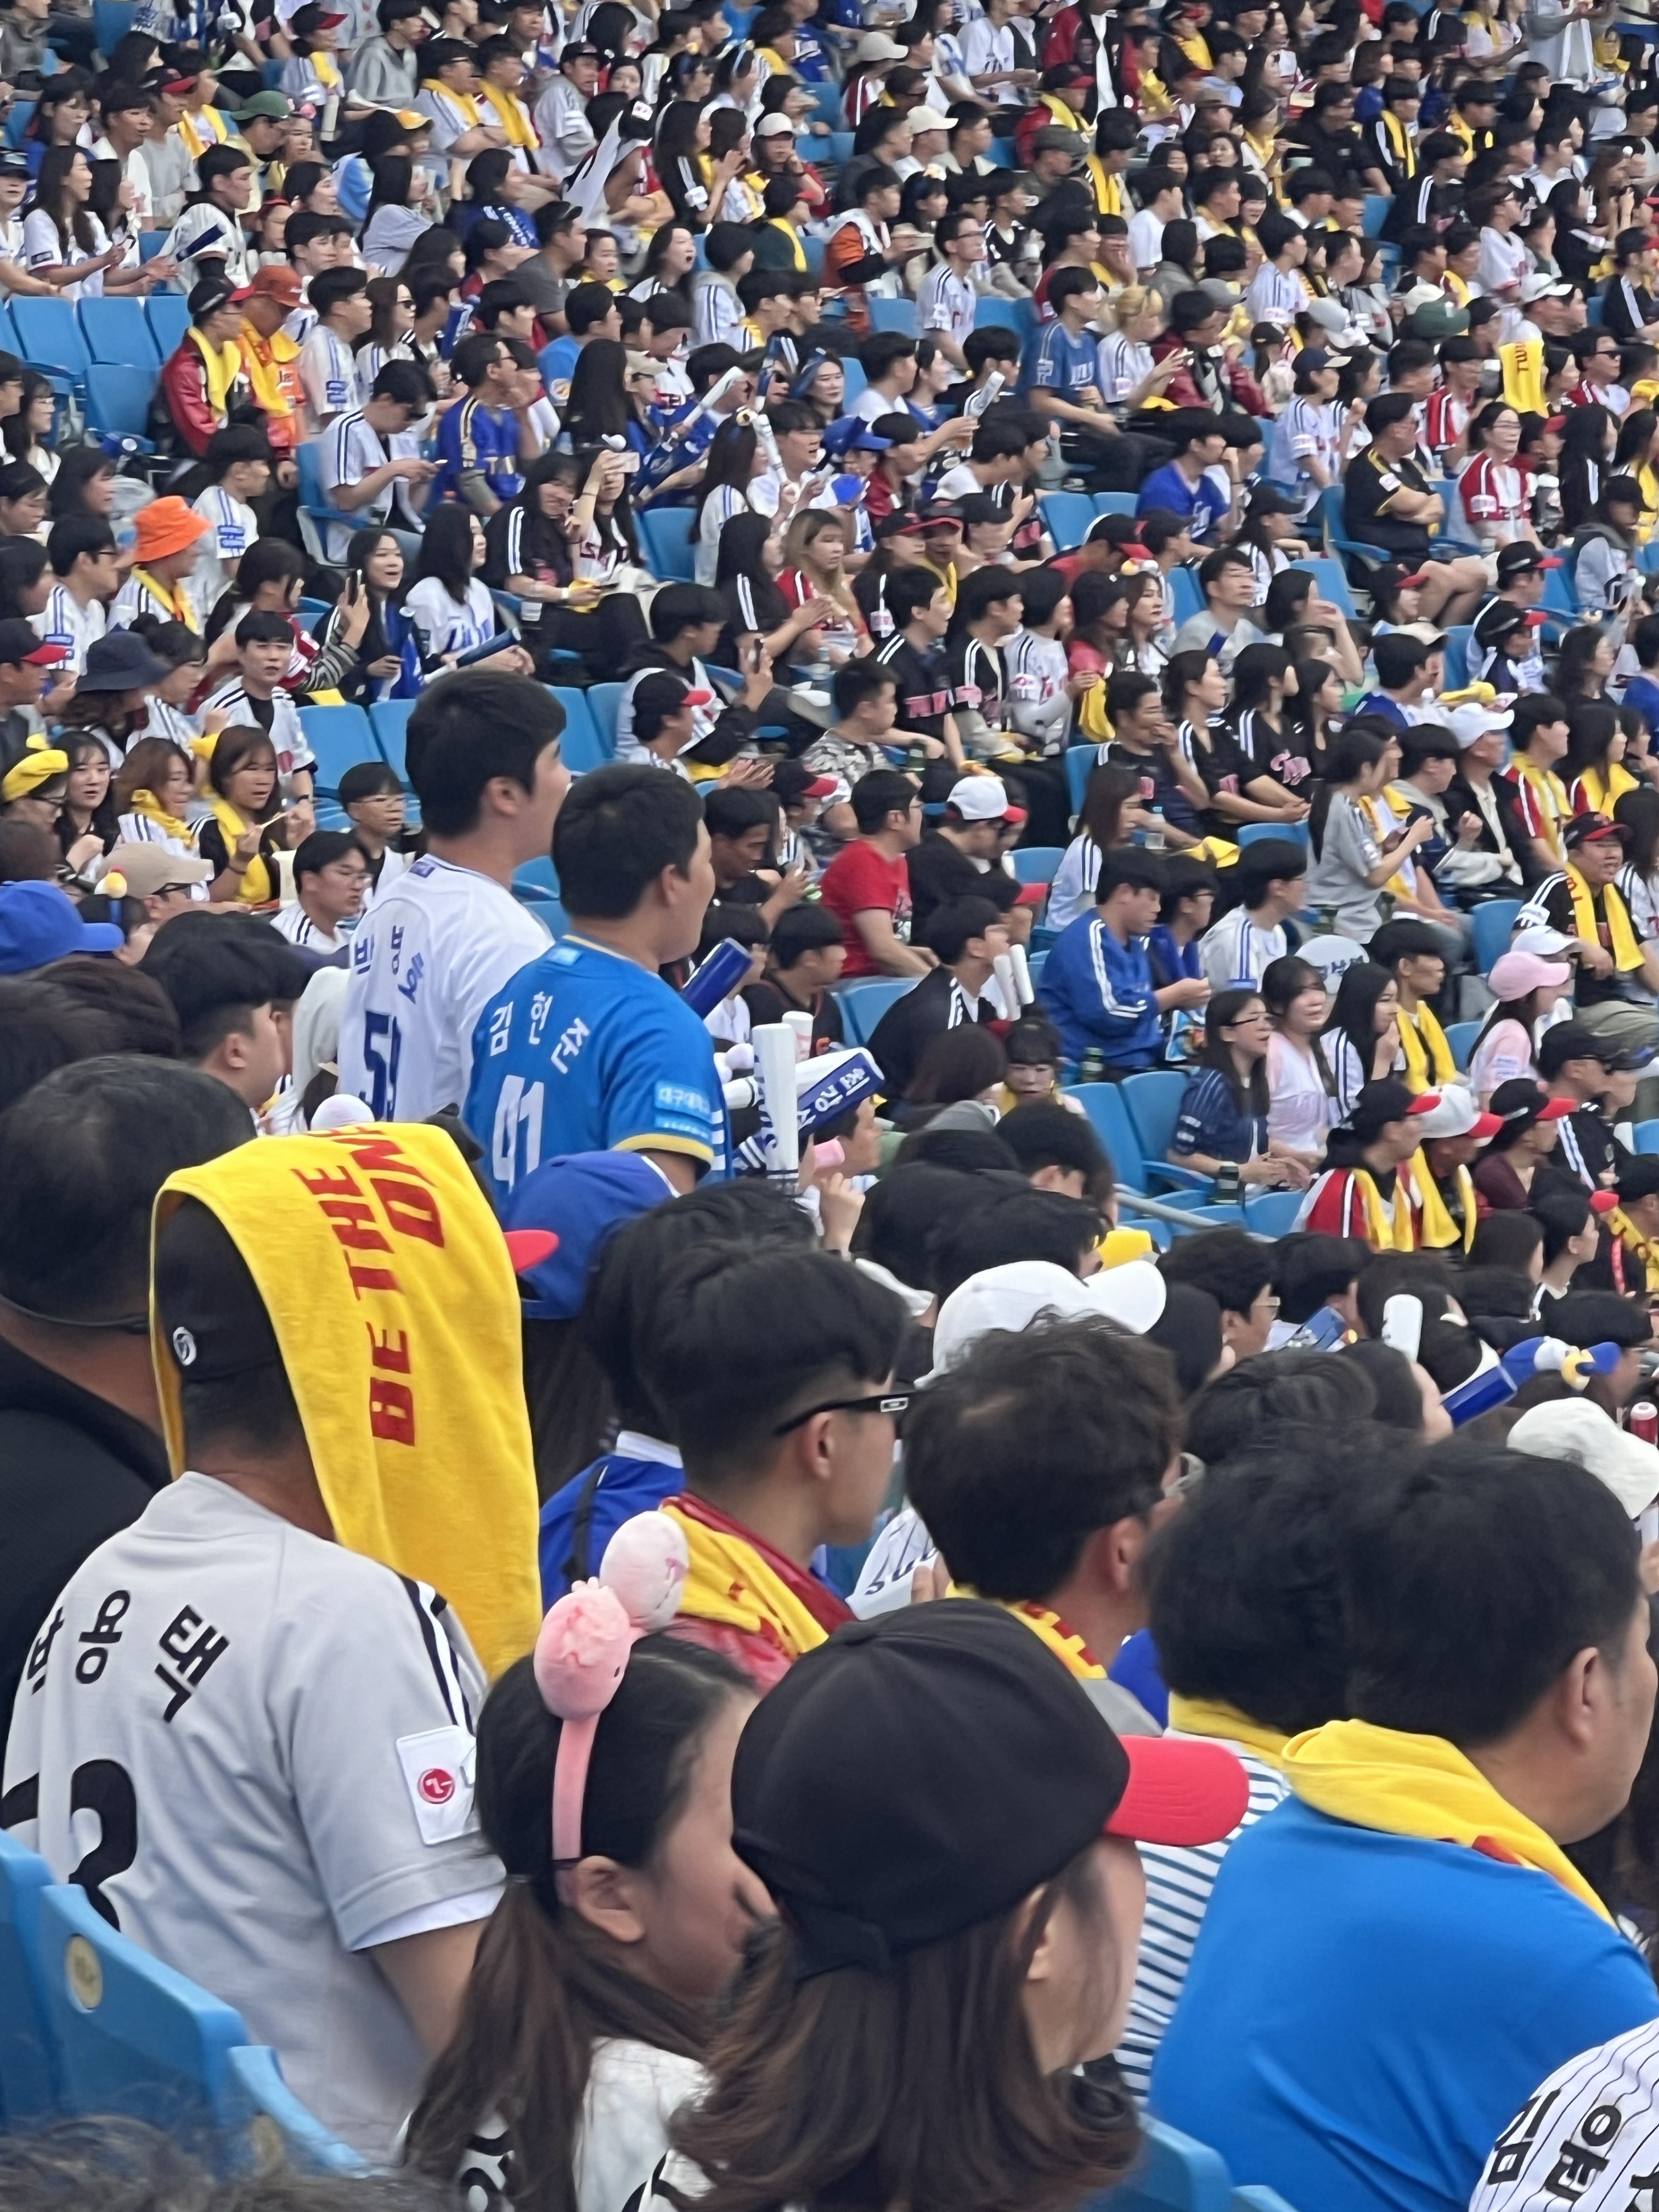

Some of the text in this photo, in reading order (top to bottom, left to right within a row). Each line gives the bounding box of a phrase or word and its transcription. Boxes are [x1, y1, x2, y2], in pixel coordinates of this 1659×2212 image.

[489, 990, 591, 1074] 김현준
[493, 1074, 545, 1188] 41
[291, 1164, 416, 1447] BE THE
